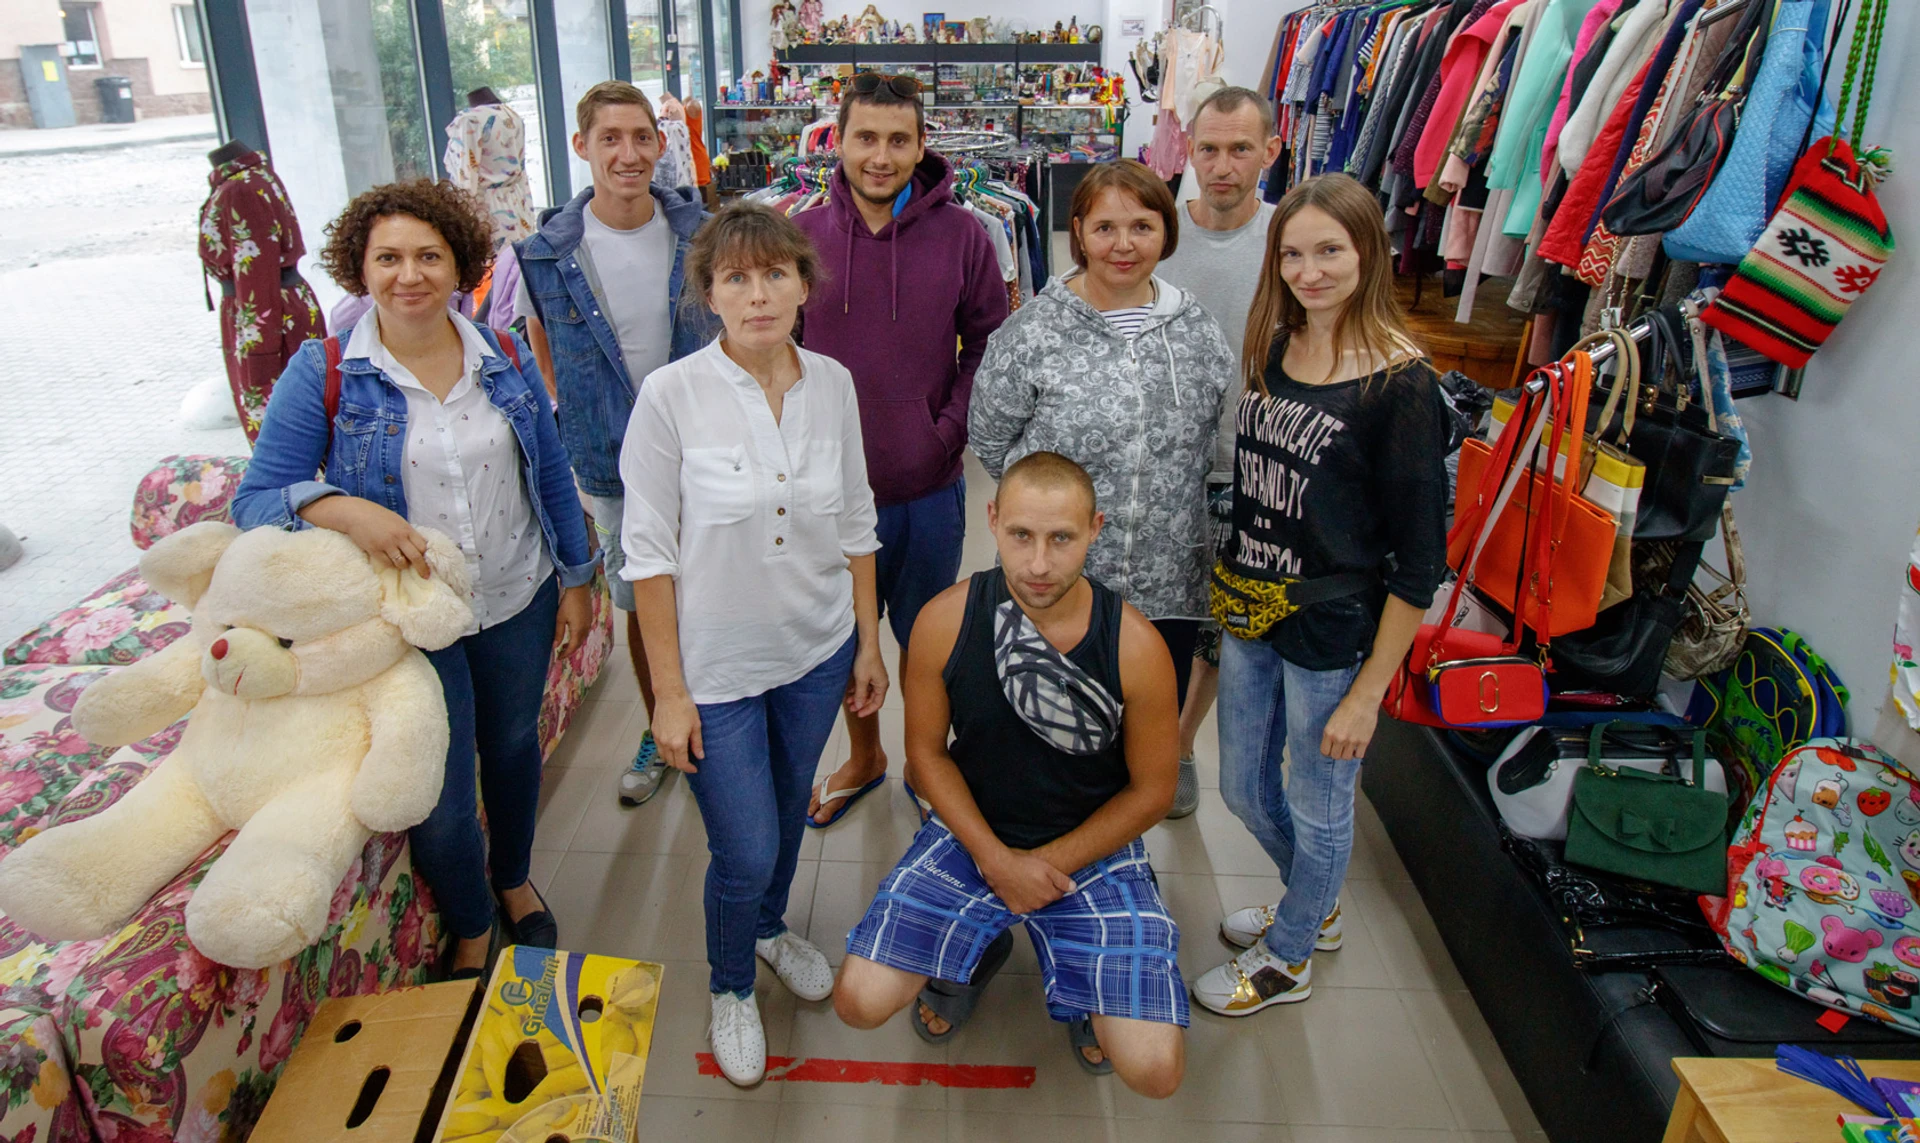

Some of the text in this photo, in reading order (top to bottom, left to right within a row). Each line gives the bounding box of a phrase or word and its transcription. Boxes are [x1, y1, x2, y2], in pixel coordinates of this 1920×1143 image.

[1236, 389, 1344, 465] OT CHOCOLATE
[522, 956, 560, 1037] Ginafruit
